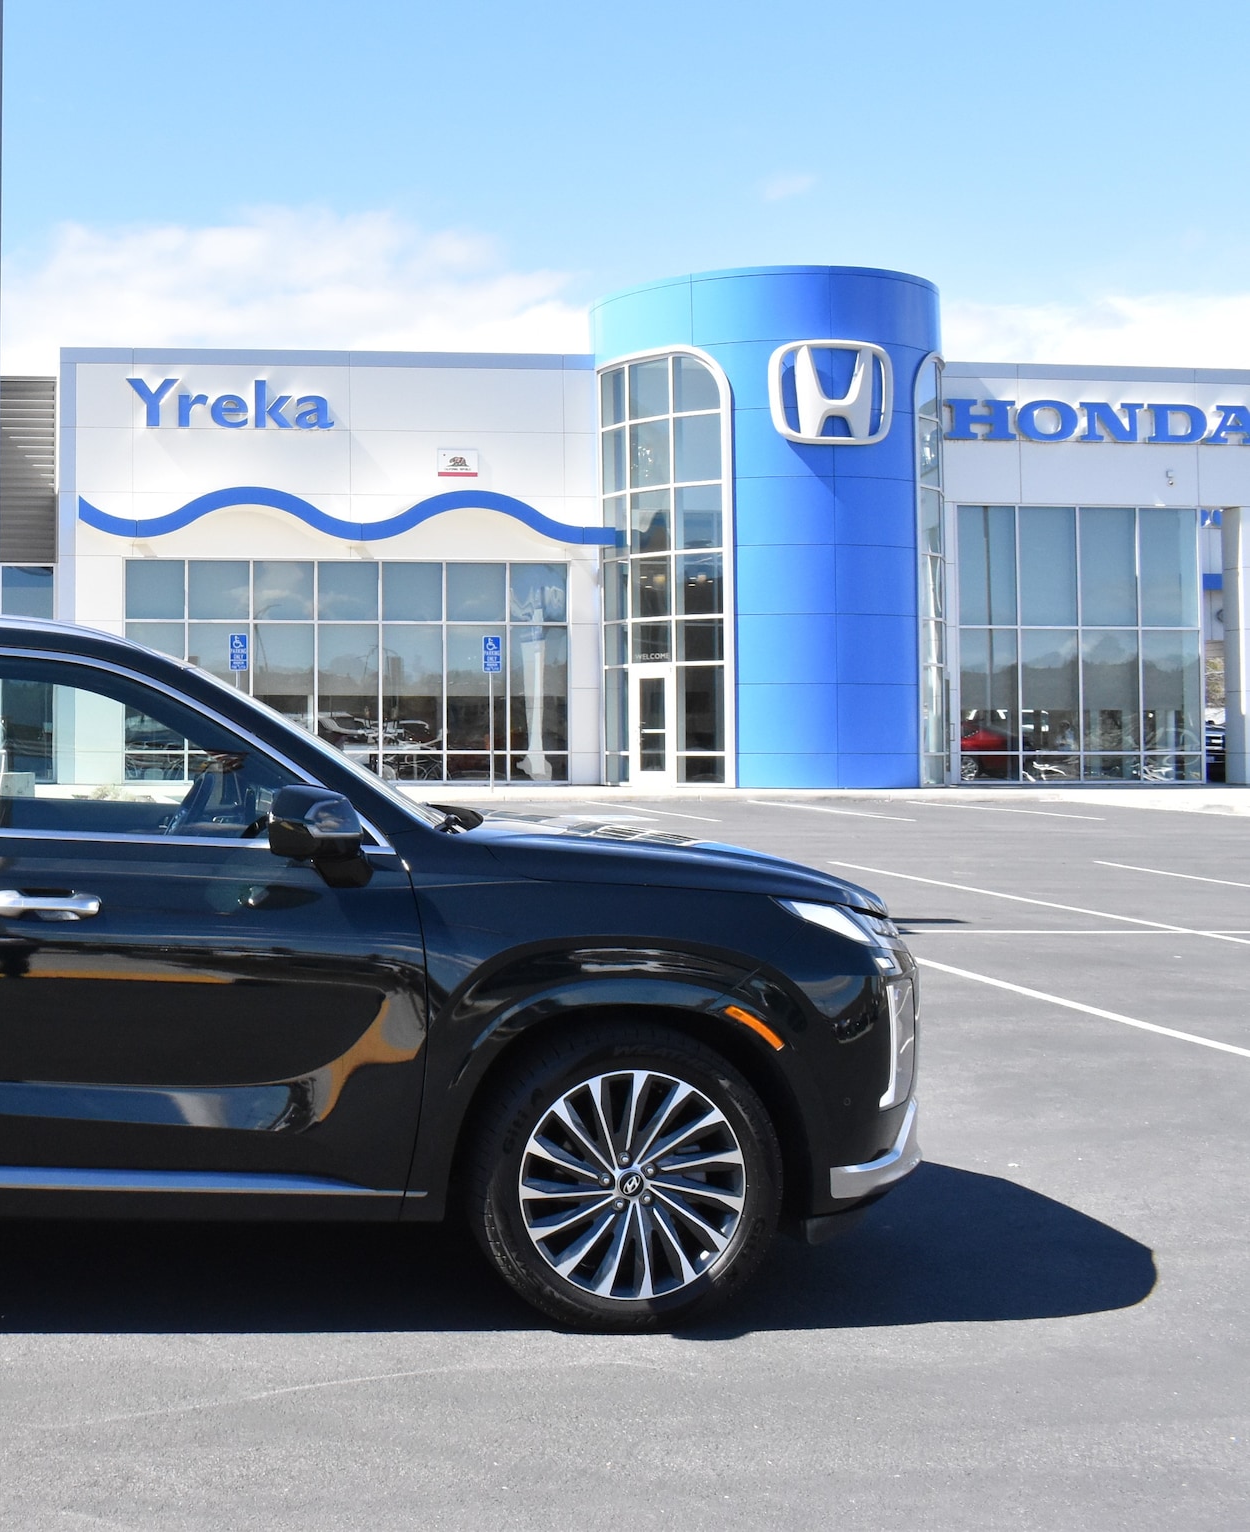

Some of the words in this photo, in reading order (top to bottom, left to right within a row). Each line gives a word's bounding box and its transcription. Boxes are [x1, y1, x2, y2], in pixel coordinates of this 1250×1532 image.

[125, 378, 335, 430] Yreka
[944, 398, 1250, 445] HONDA
[635, 652, 671, 661] WELCOME
